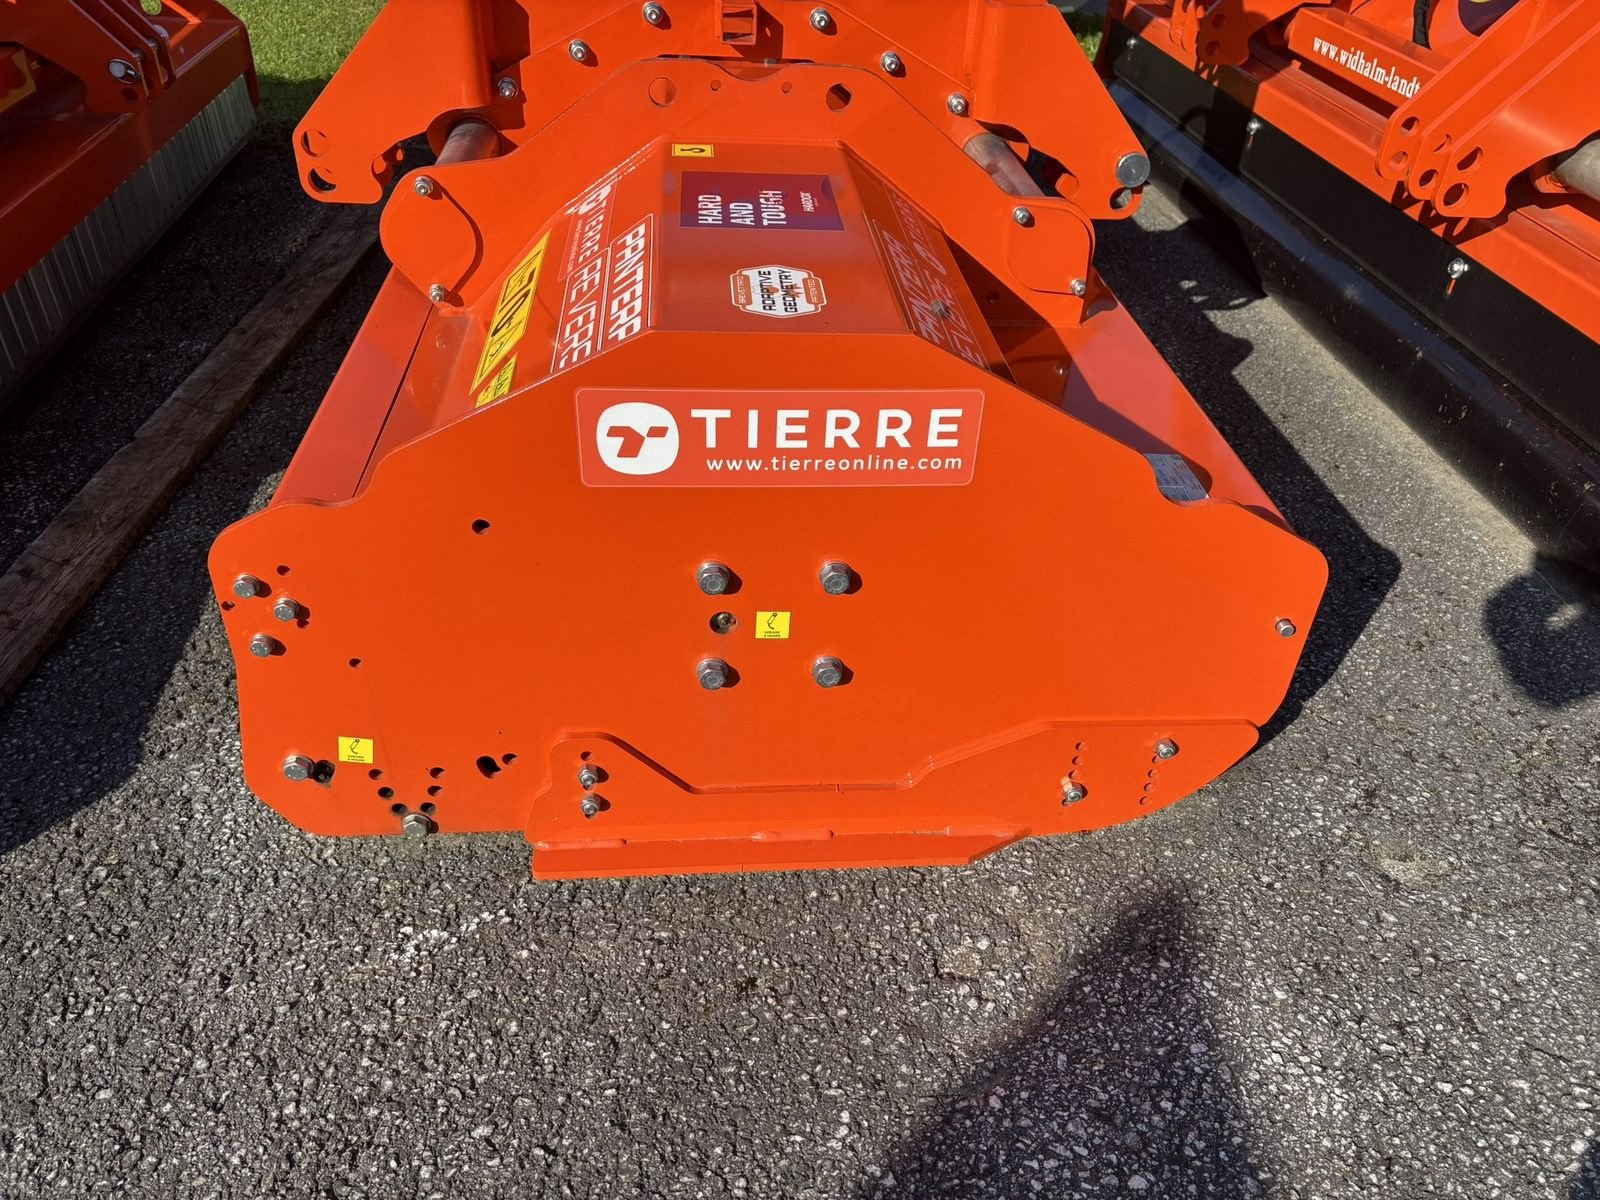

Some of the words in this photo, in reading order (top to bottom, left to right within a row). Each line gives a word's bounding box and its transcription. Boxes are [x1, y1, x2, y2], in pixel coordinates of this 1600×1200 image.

[698, 194, 723, 224] HARD
[729, 202, 755, 226] AND
[759, 190, 787, 226] TOUGH
[800, 191, 815, 213] HARDOX
[578, 198, 608, 263] TIERRE
[758, 270, 777, 311] ADAPTIVE
[778, 269, 798, 313] GEOMETRY
[690, 408, 963, 449] TIERRE
[706, 455, 962, 472] www.tierreonline.com
